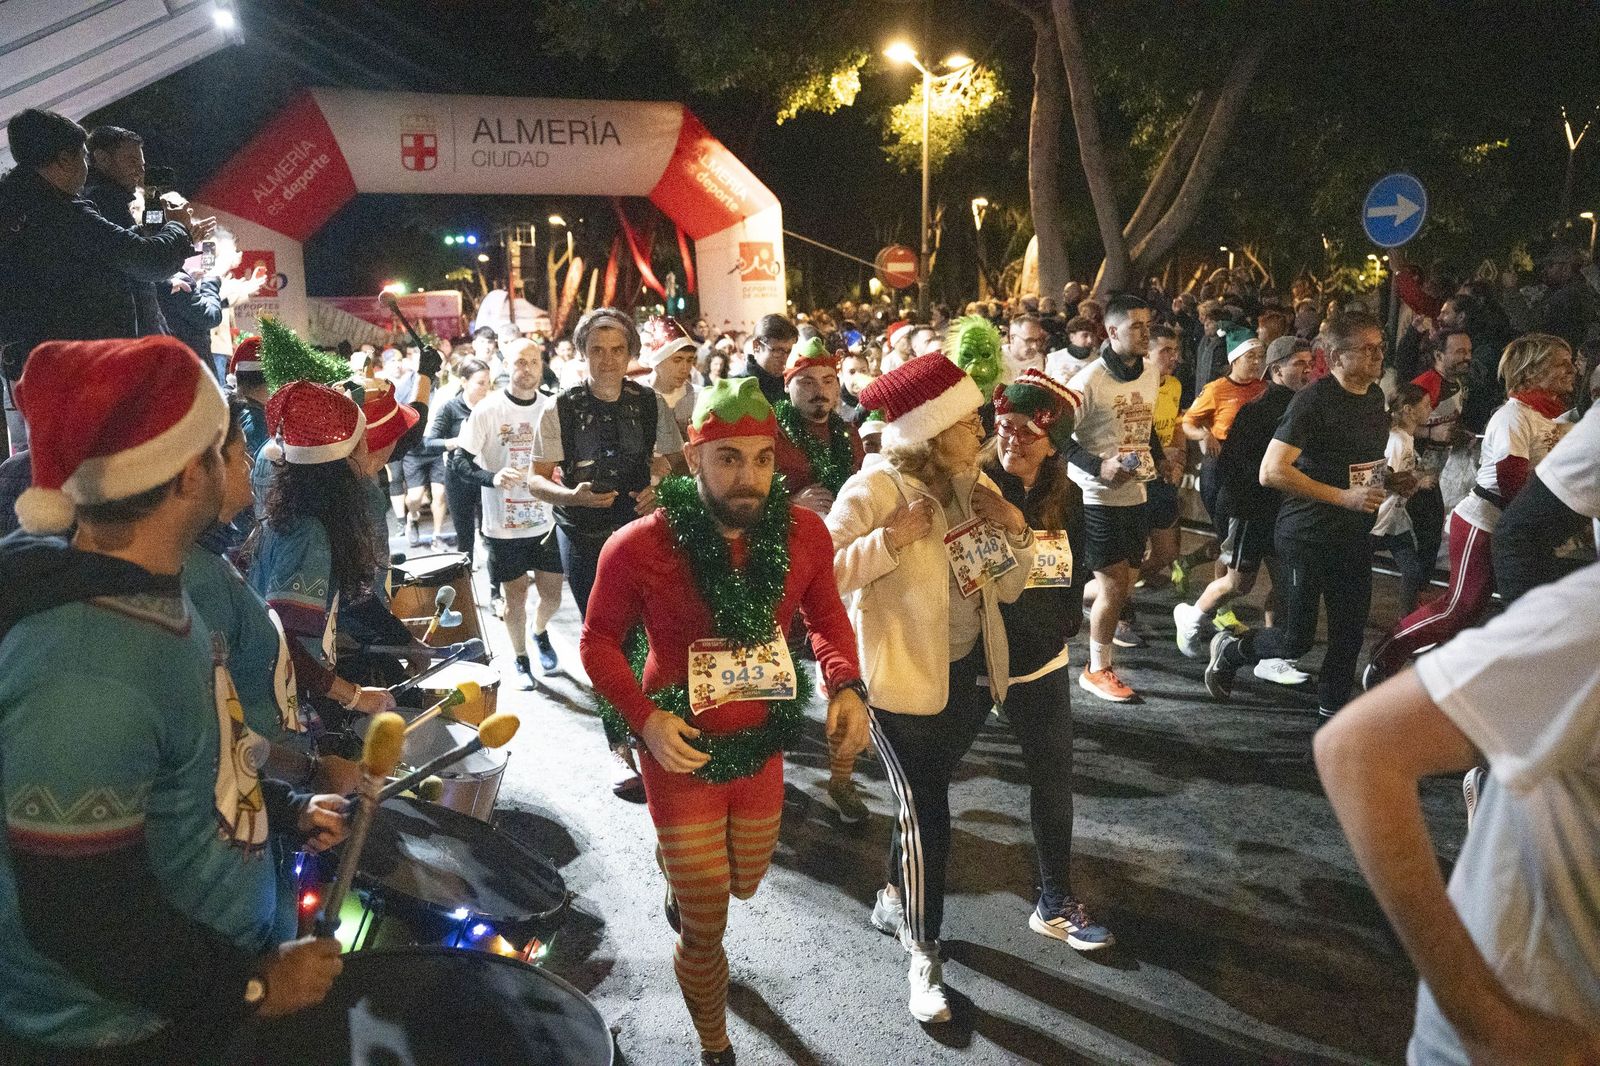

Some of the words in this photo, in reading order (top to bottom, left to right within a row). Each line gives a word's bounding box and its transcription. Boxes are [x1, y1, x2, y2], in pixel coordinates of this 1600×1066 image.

[472, 115, 621, 145] ALMERÍA
[472, 151, 549, 167] CIUDAD
[267, 199, 284, 216] es
[283, 153, 331, 200] deporte
[696, 171, 739, 213] deporte
[721, 665, 764, 686] 943
